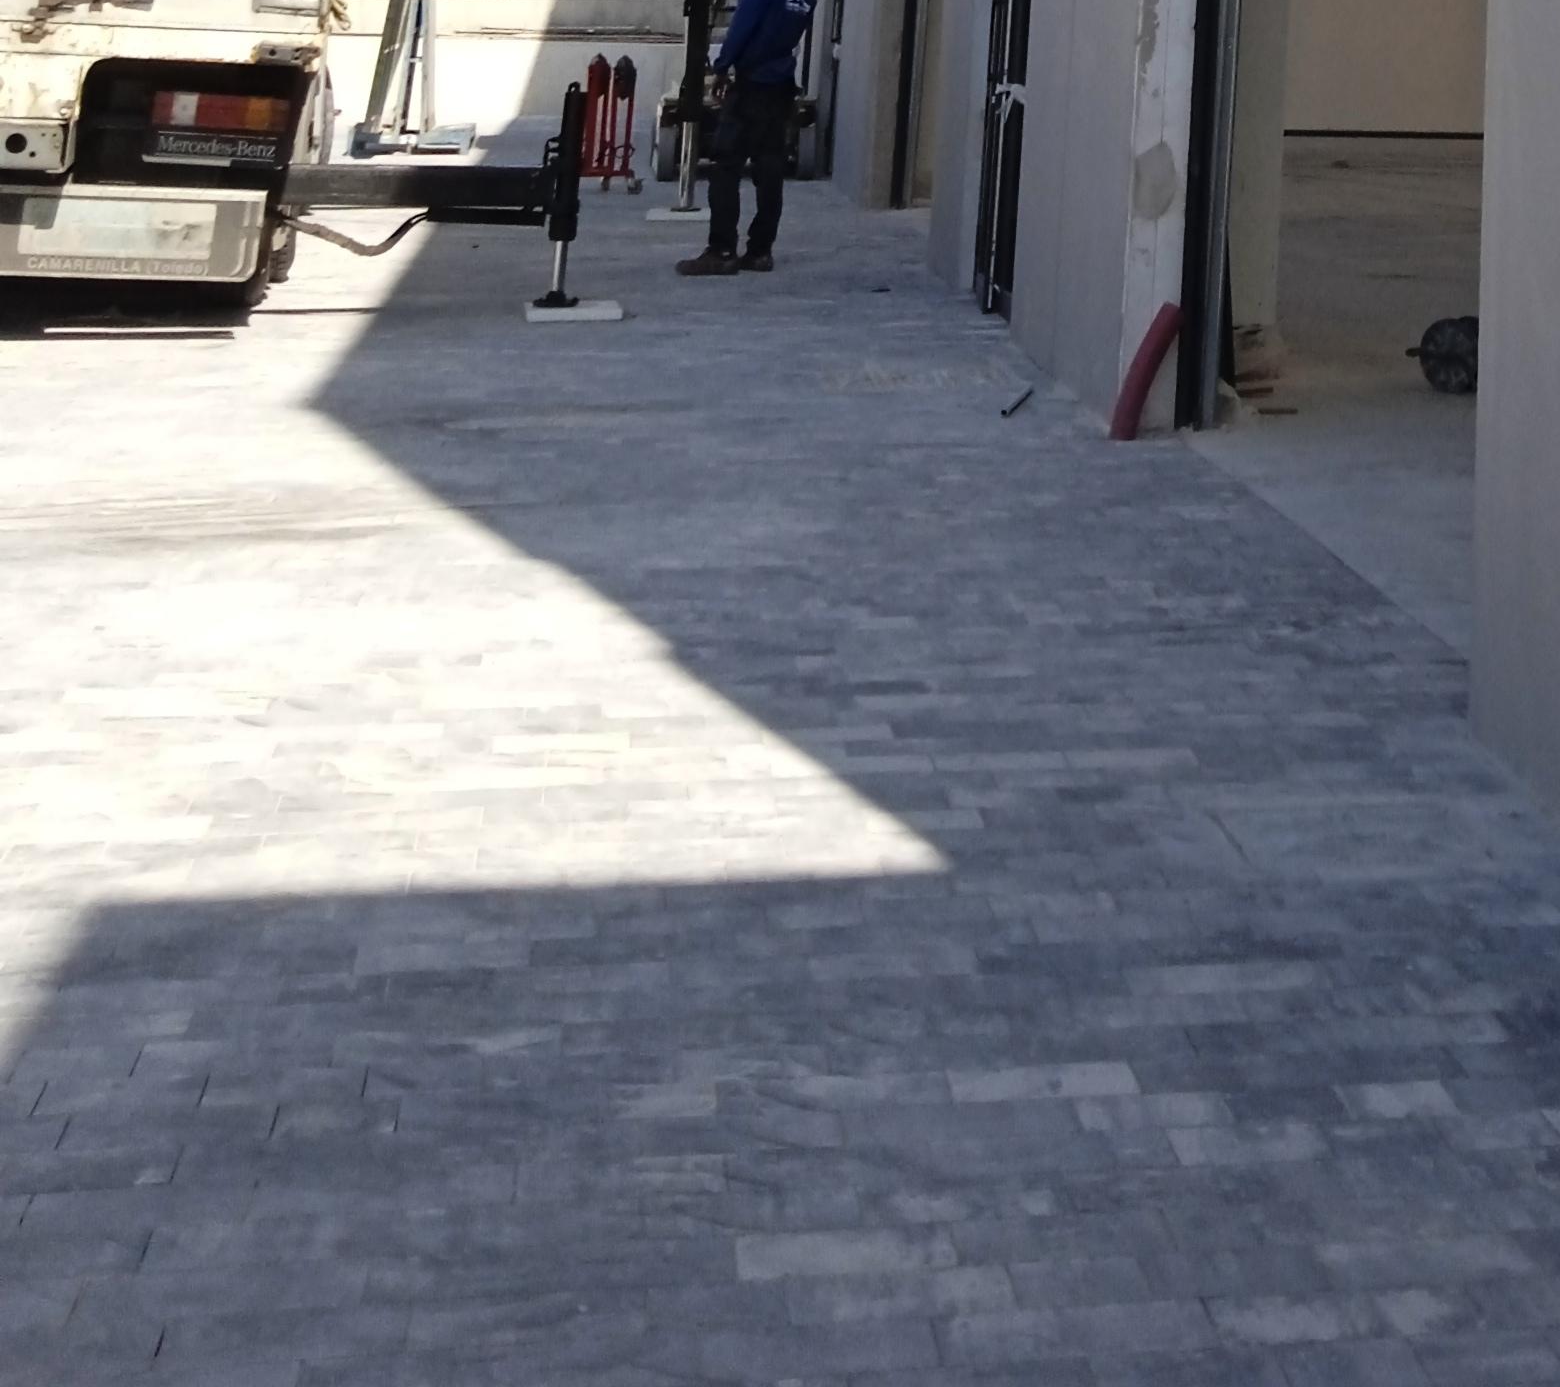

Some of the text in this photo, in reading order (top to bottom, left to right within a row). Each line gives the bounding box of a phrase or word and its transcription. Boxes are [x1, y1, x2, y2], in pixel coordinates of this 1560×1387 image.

[158, 135, 277, 158] Mercedes-Benz
[26, 257, 210, 278] CAMARENILLA (Toledo)
